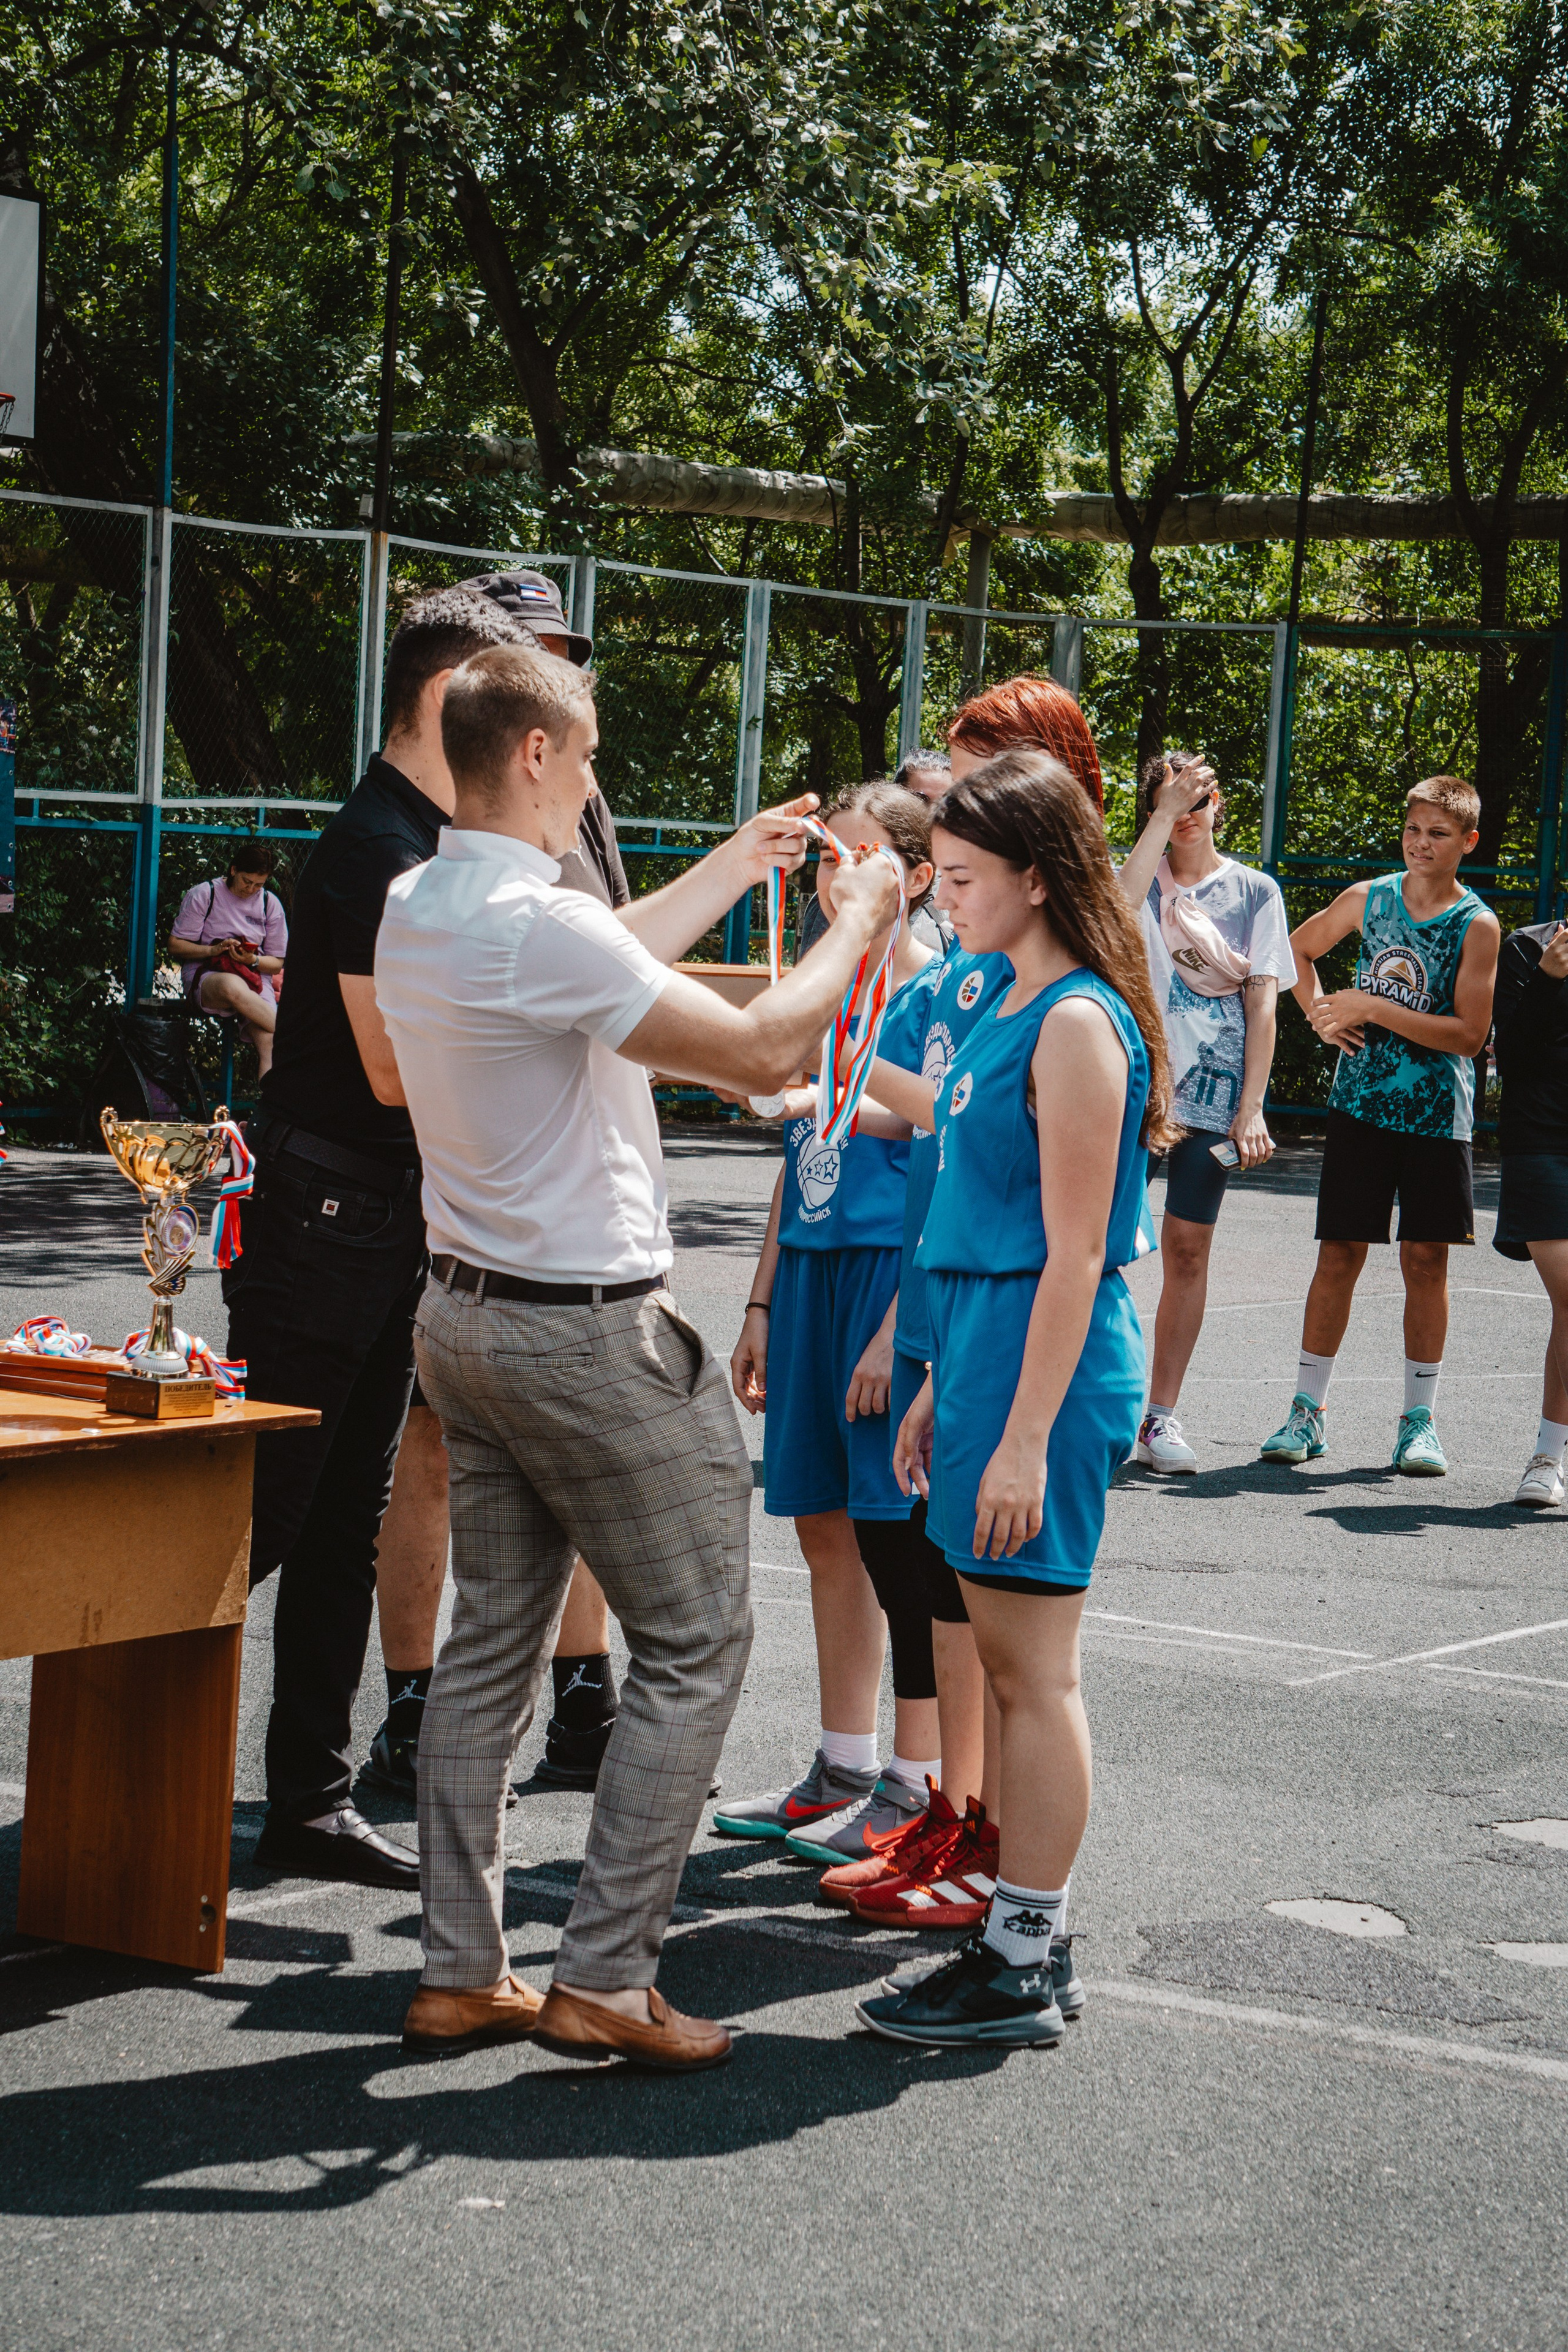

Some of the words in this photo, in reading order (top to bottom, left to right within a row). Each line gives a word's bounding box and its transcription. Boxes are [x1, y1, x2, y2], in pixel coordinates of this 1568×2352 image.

[1182, 947, 1205, 971] NIKE
[1374, 953, 1390, 974] RUSSIAN
[790, 1118, 816, 1147] ЗВЕЗ
[165, 1384, 212, 1392] ПОБЕДИТЕЛЬ
[1003, 1919, 1051, 1937] Kappa
